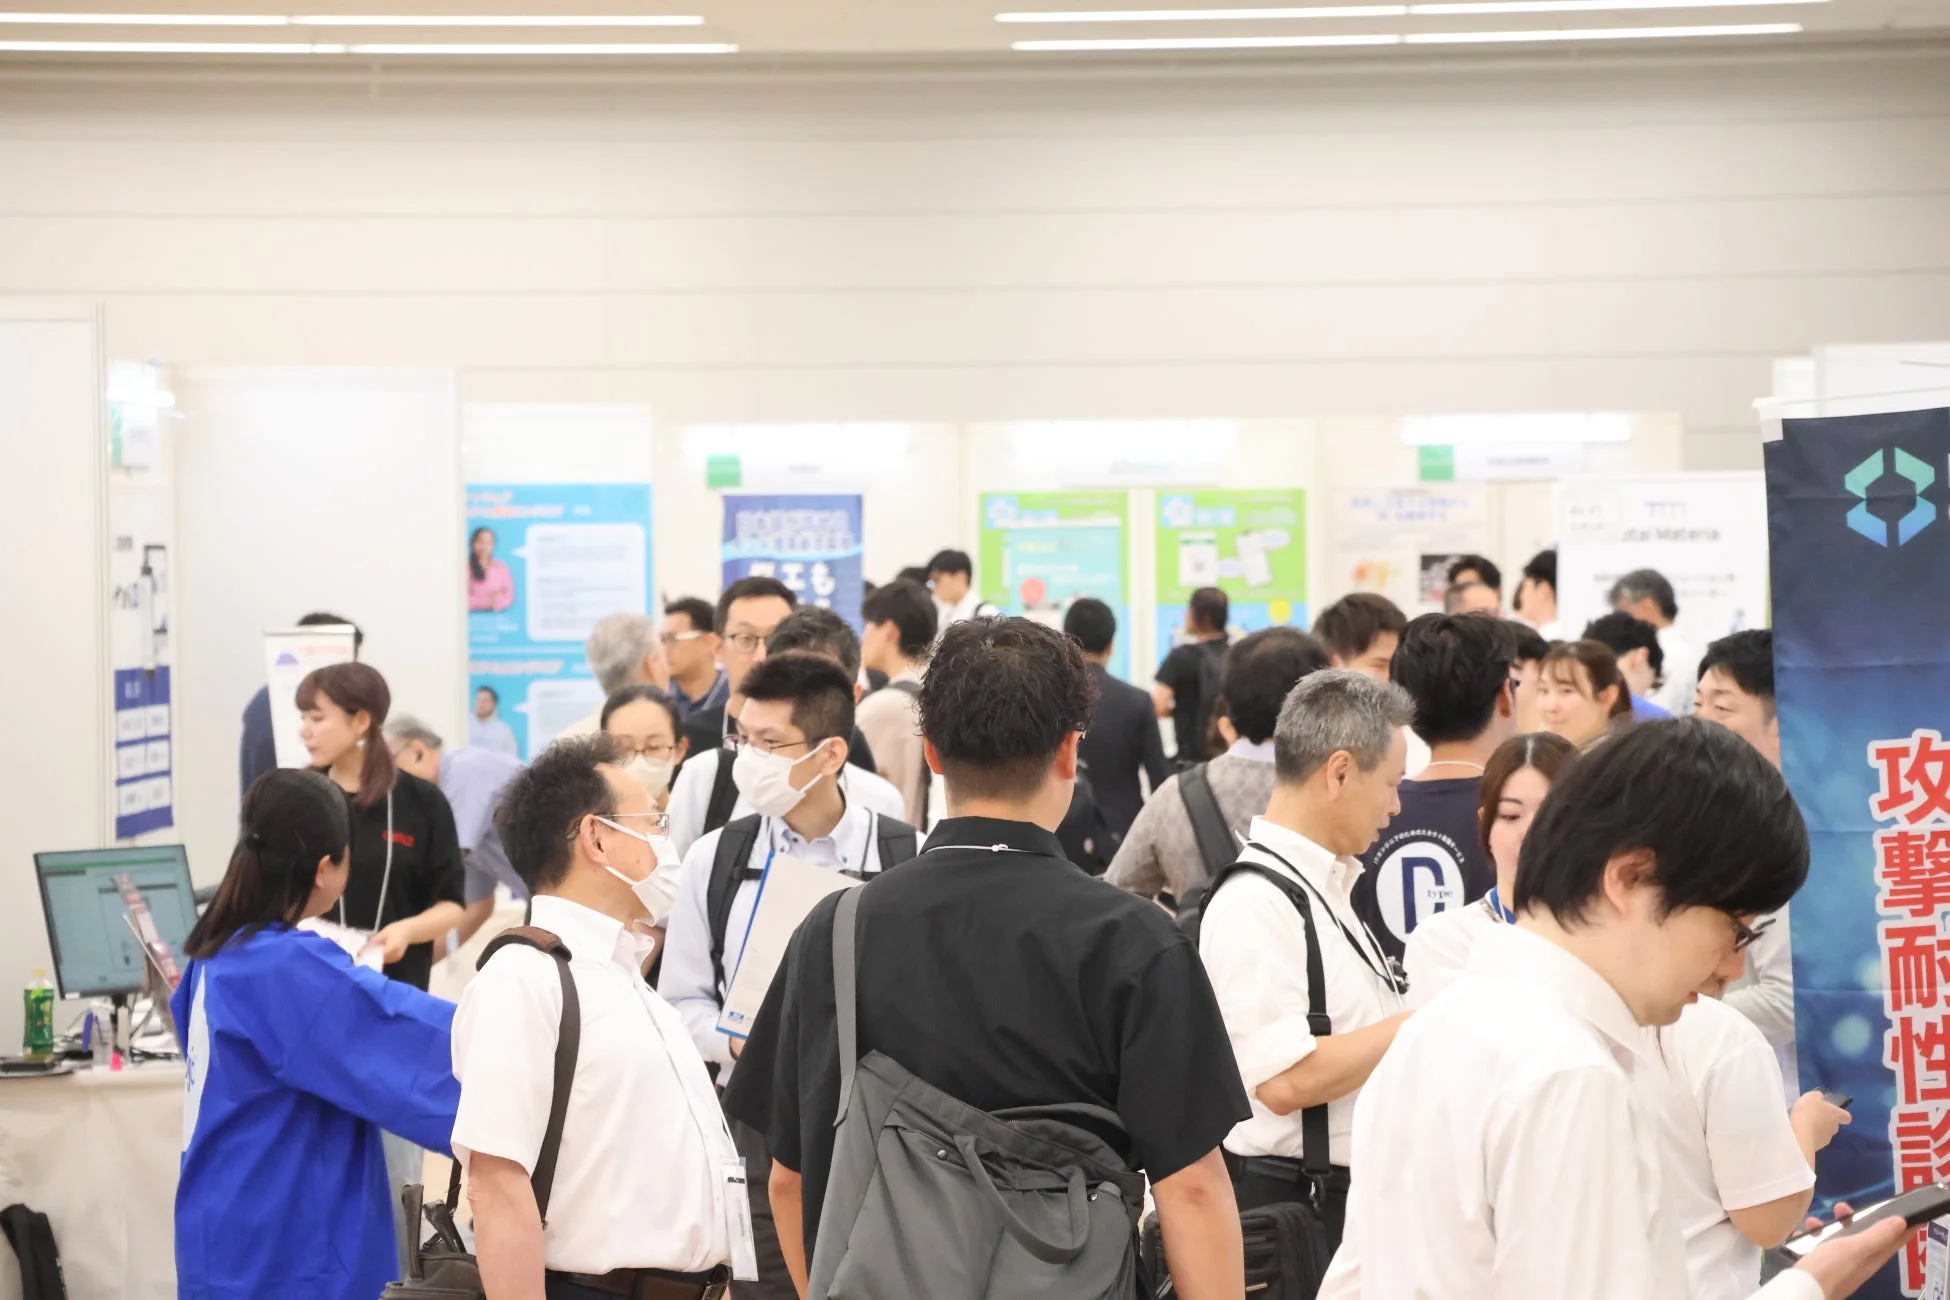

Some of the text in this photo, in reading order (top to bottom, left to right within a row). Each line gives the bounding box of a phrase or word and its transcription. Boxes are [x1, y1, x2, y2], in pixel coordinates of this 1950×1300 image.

[1427, 889, 1453, 900] type
[1874, 735, 1950, 1291] 攻撃耐性診
